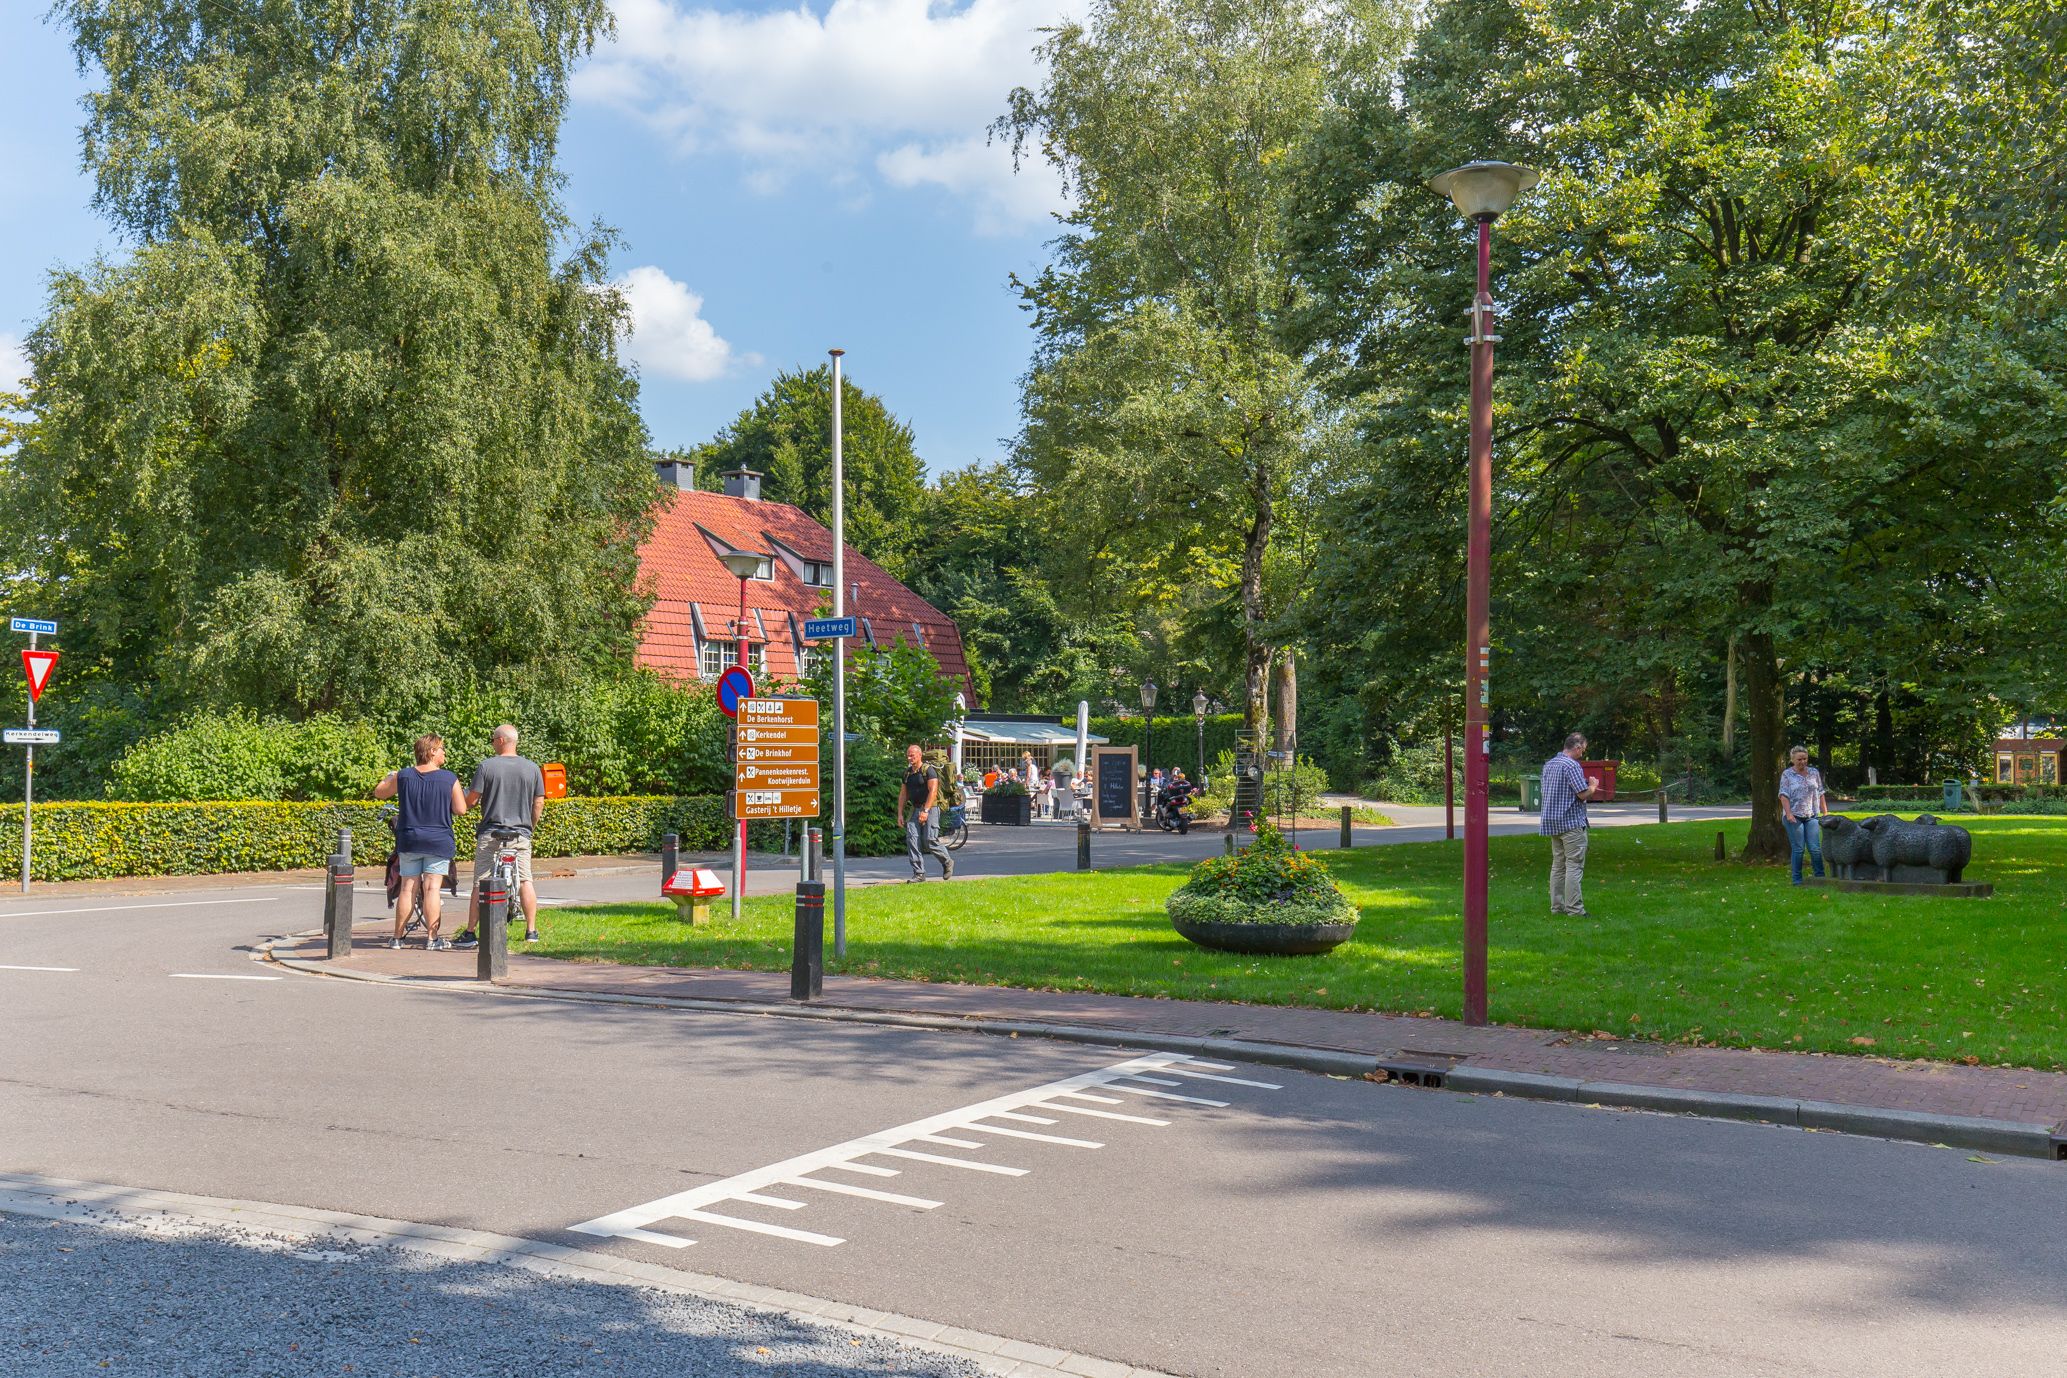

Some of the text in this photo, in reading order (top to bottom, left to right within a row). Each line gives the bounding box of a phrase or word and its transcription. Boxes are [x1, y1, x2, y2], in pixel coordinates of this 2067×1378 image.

[15, 621, 53, 632] De Brink
[808, 623, 849, 633] Heetweg
[757, 715, 793, 723] Berkenhorst
[756, 749, 792, 757] De Brinkhof
[756, 768, 808, 776] Pannenkoekenrest.
[768, 777, 810, 786] Kootwijkerduin
[746, 806, 771, 815] Gasterij
[779, 805, 801, 814] Hilletje
